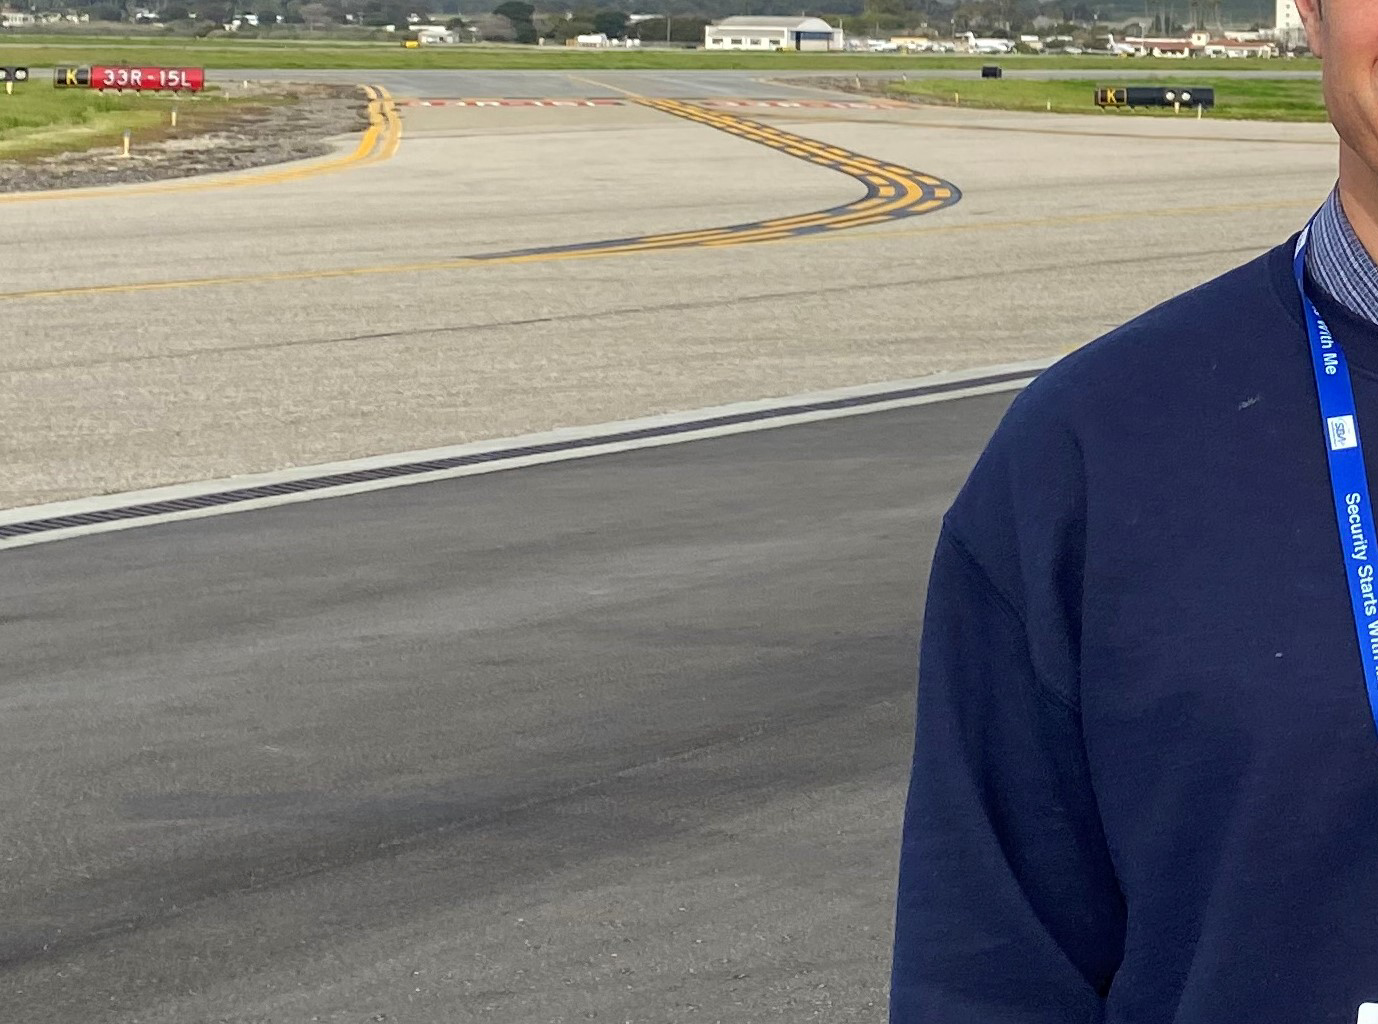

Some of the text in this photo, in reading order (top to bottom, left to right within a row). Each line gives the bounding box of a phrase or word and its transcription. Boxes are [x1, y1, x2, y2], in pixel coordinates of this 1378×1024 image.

[66, 68, 78, 85] K
[1107, 87, 1117, 104] K
[1322, 353, 1339, 375] Me
[1345, 492, 1368, 561] Security
[1357, 564, 1378, 617] Starts
